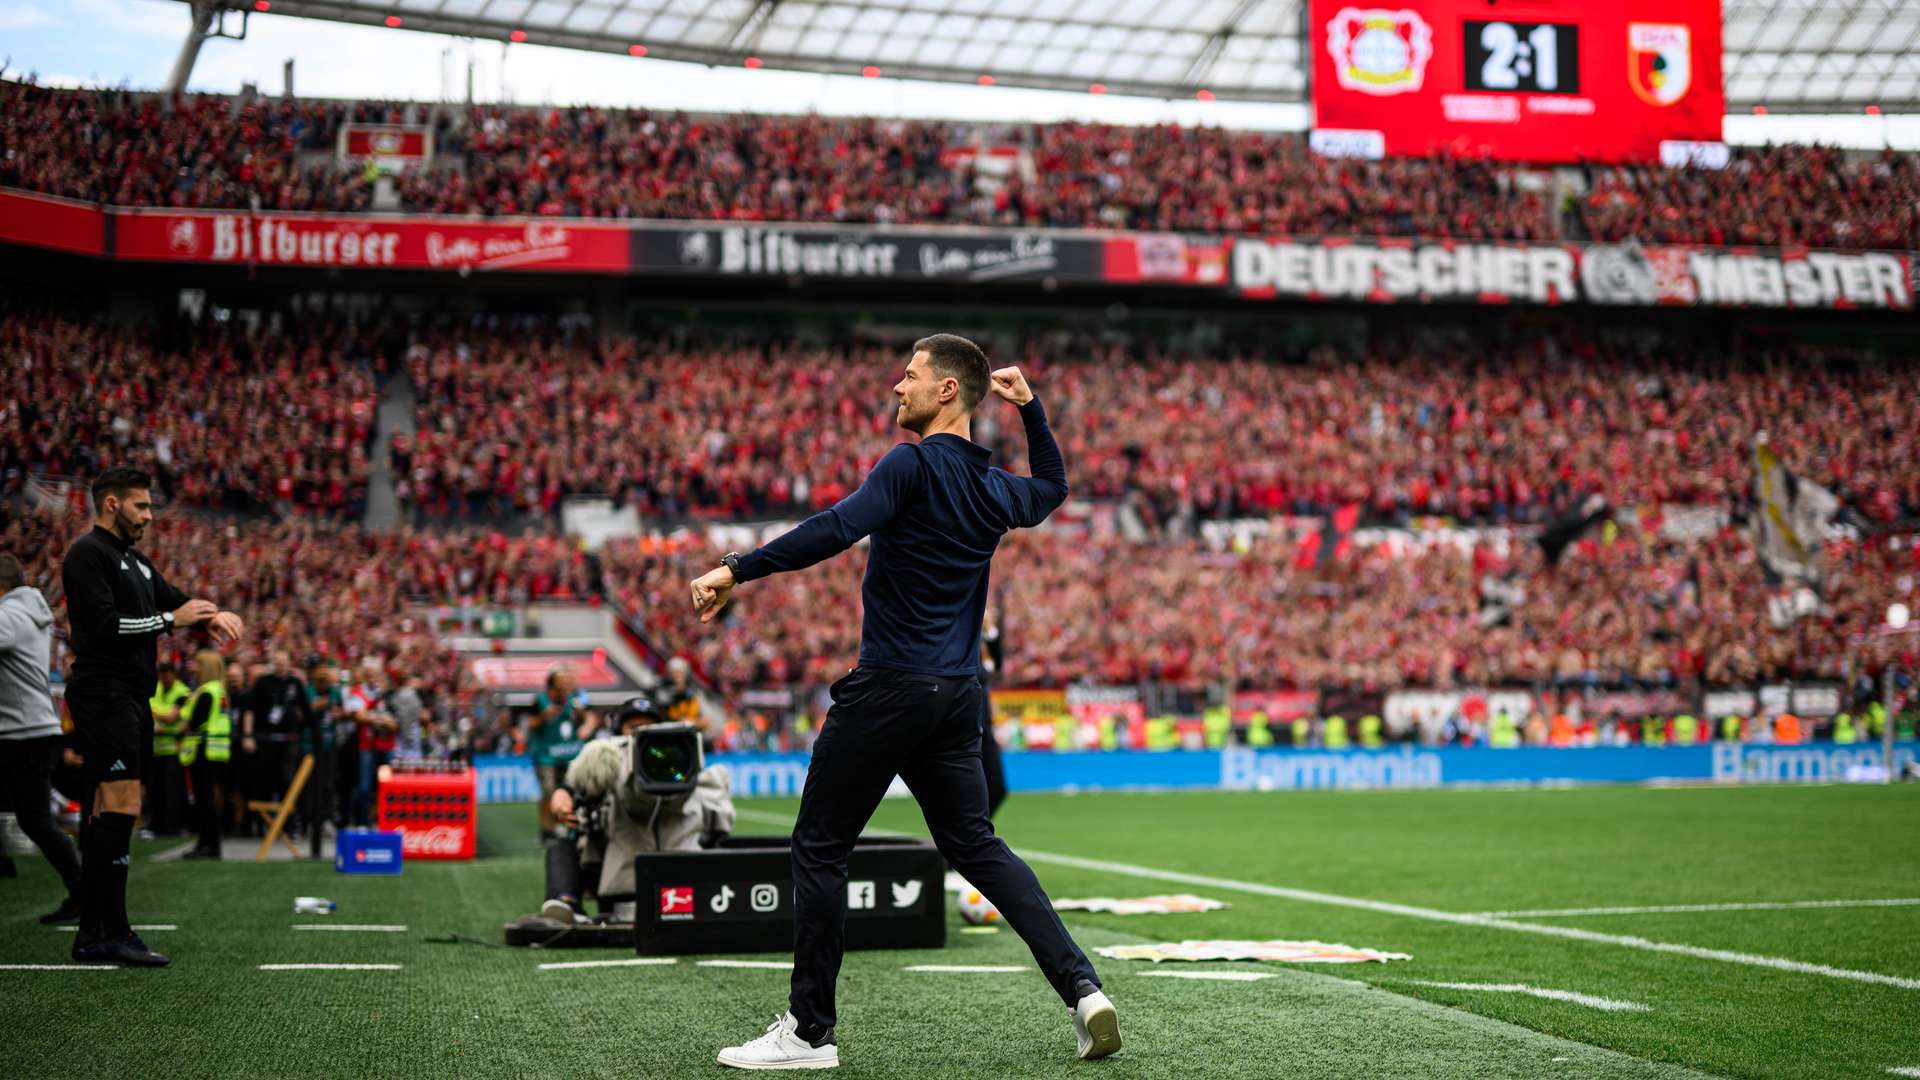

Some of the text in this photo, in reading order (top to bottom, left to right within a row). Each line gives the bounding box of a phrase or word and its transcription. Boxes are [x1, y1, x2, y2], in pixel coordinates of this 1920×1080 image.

[1481, 22, 1558, 90] 2:1
[212, 214, 398, 265] Bitburger
[721, 227, 898, 275] Bitburger
[1233, 240, 1576, 302] DEUTSCHER
[1688, 251, 1909, 307] MEISTER
[1220, 743, 1442, 790] Barmenia
